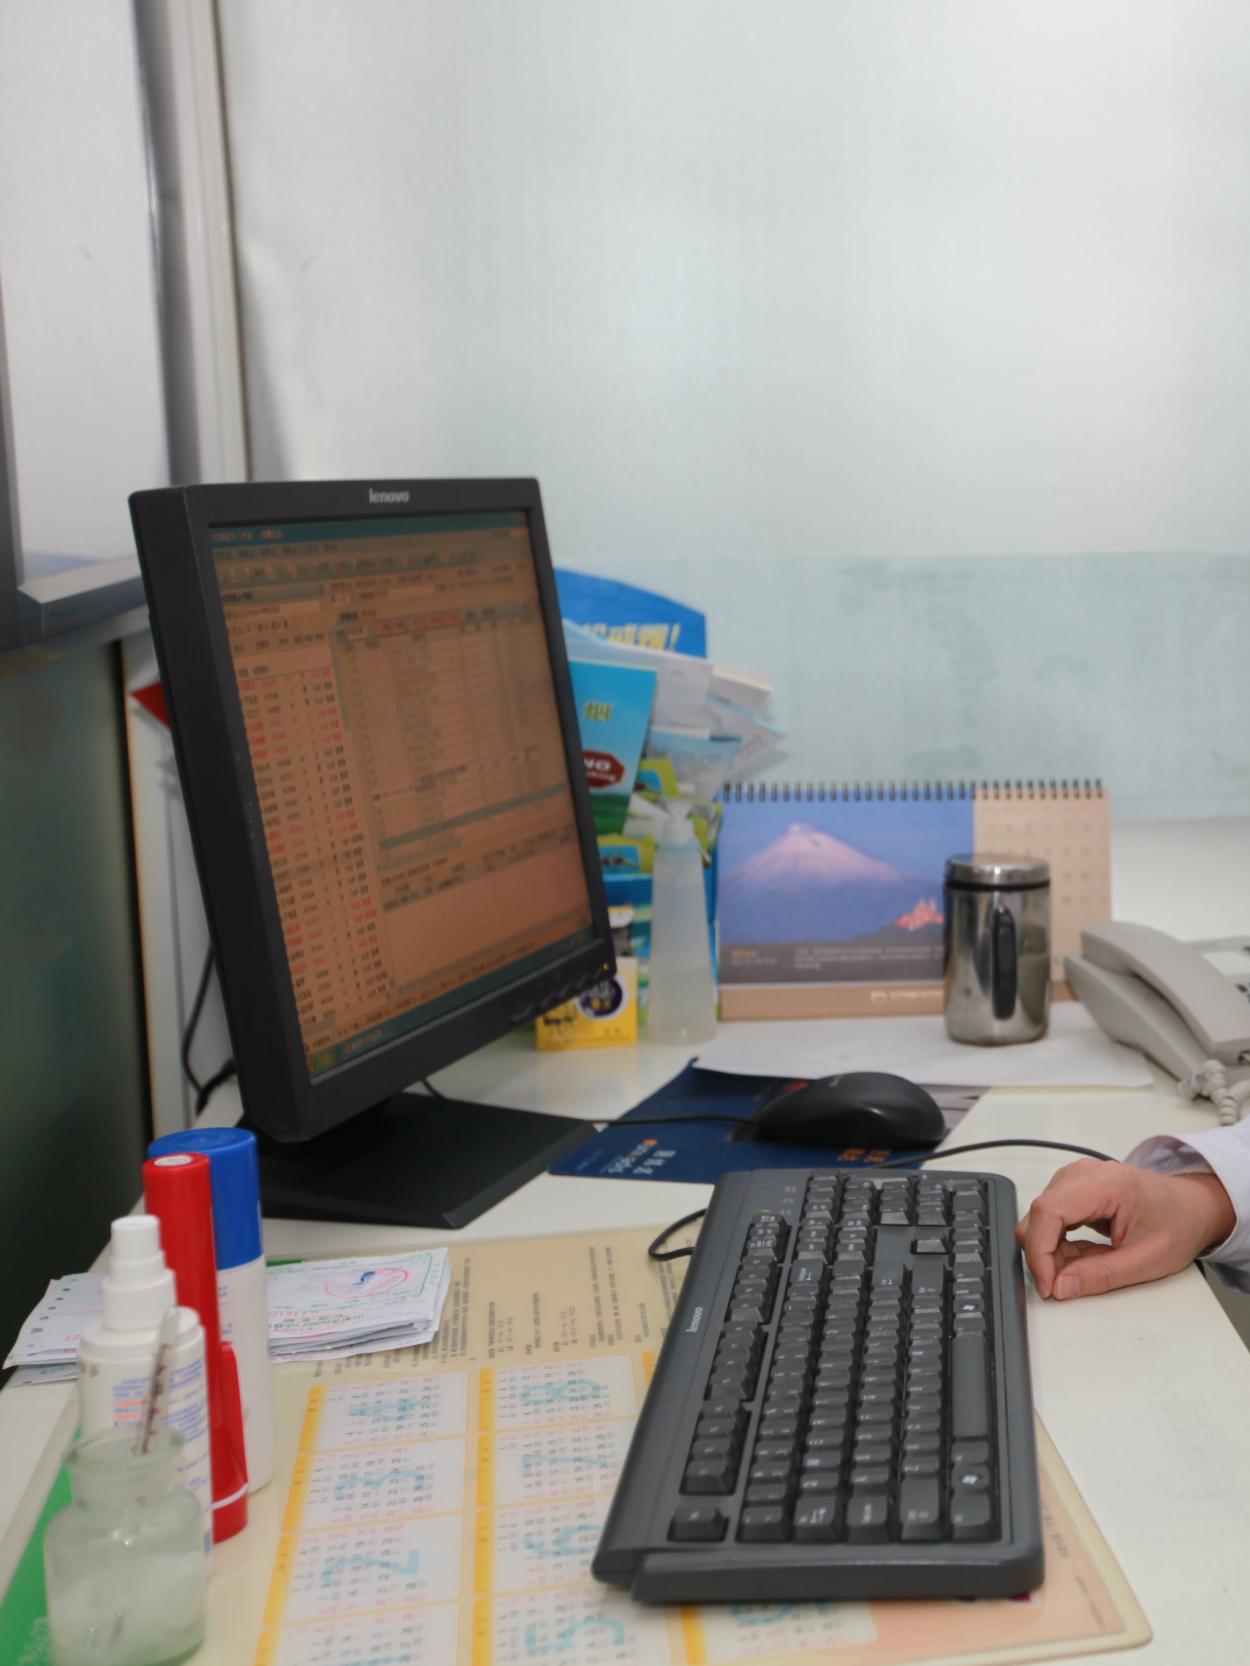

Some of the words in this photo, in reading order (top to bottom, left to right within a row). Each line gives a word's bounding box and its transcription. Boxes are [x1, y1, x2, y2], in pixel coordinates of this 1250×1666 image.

[368, 488, 410, 504] lenovo
[686, 1306, 703, 1332] lenovo
[520, 1379, 604, 1405] 8
[521, 1454, 609, 1477] 7
[333, 1470, 425, 1500] 3
[320, 1548, 421, 1586] 2
[525, 1617, 626, 1656] 5
